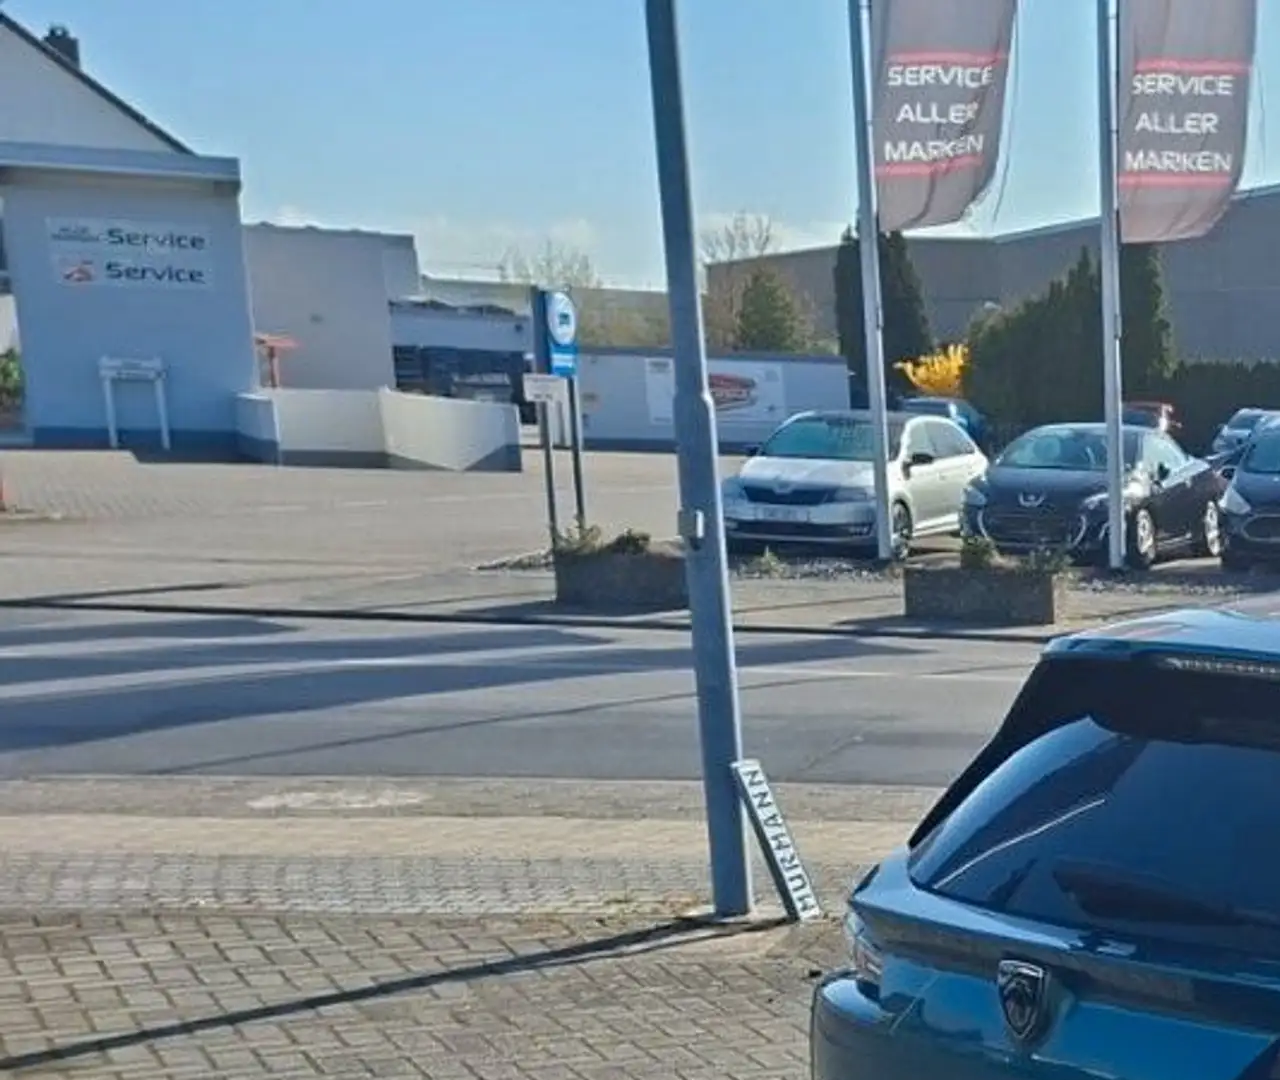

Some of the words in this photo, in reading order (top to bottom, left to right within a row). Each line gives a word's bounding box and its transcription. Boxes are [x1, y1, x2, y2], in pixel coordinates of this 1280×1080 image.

[888, 65, 993, 88] SERVICE
[1132, 73, 1233, 96] SERVICE
[1135, 112, 1219, 134] ALLER
[884, 134, 984, 162] MARKEN
[1124, 149, 1233, 172] MARKEN
[106, 228, 206, 251] Service
[105, 261, 207, 285] Service
